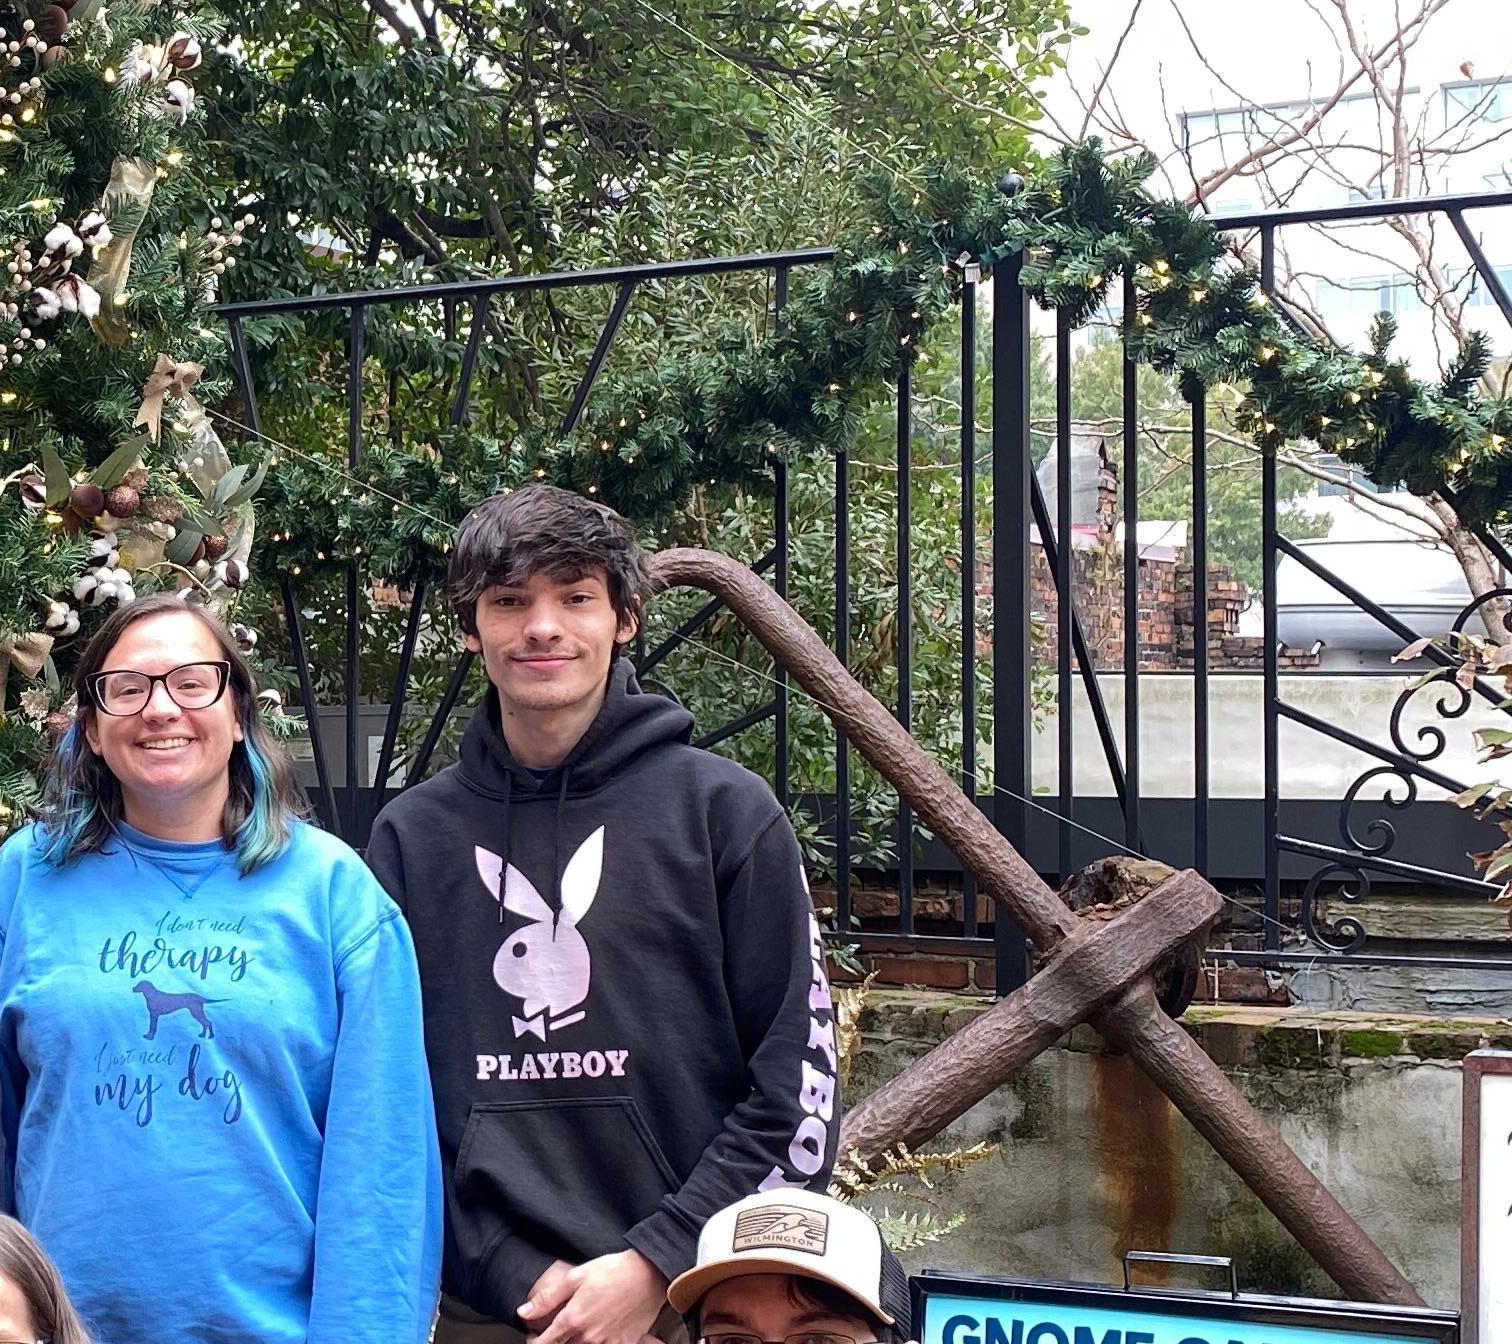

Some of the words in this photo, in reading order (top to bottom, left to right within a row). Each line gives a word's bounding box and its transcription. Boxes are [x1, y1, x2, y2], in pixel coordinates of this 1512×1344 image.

[155, 910, 171, 936] I
[166, 916, 208, 934] don't
[209, 915, 246, 934] need
[98, 930, 255, 982] therapy
[138, 1045, 176, 1066] need
[476, 1050, 629, 1080] PLAYBOY
[95, 1074, 163, 1127] my
[178, 1043, 243, 1125] dog
[743, 1234, 814, 1247] WILMINGTON
